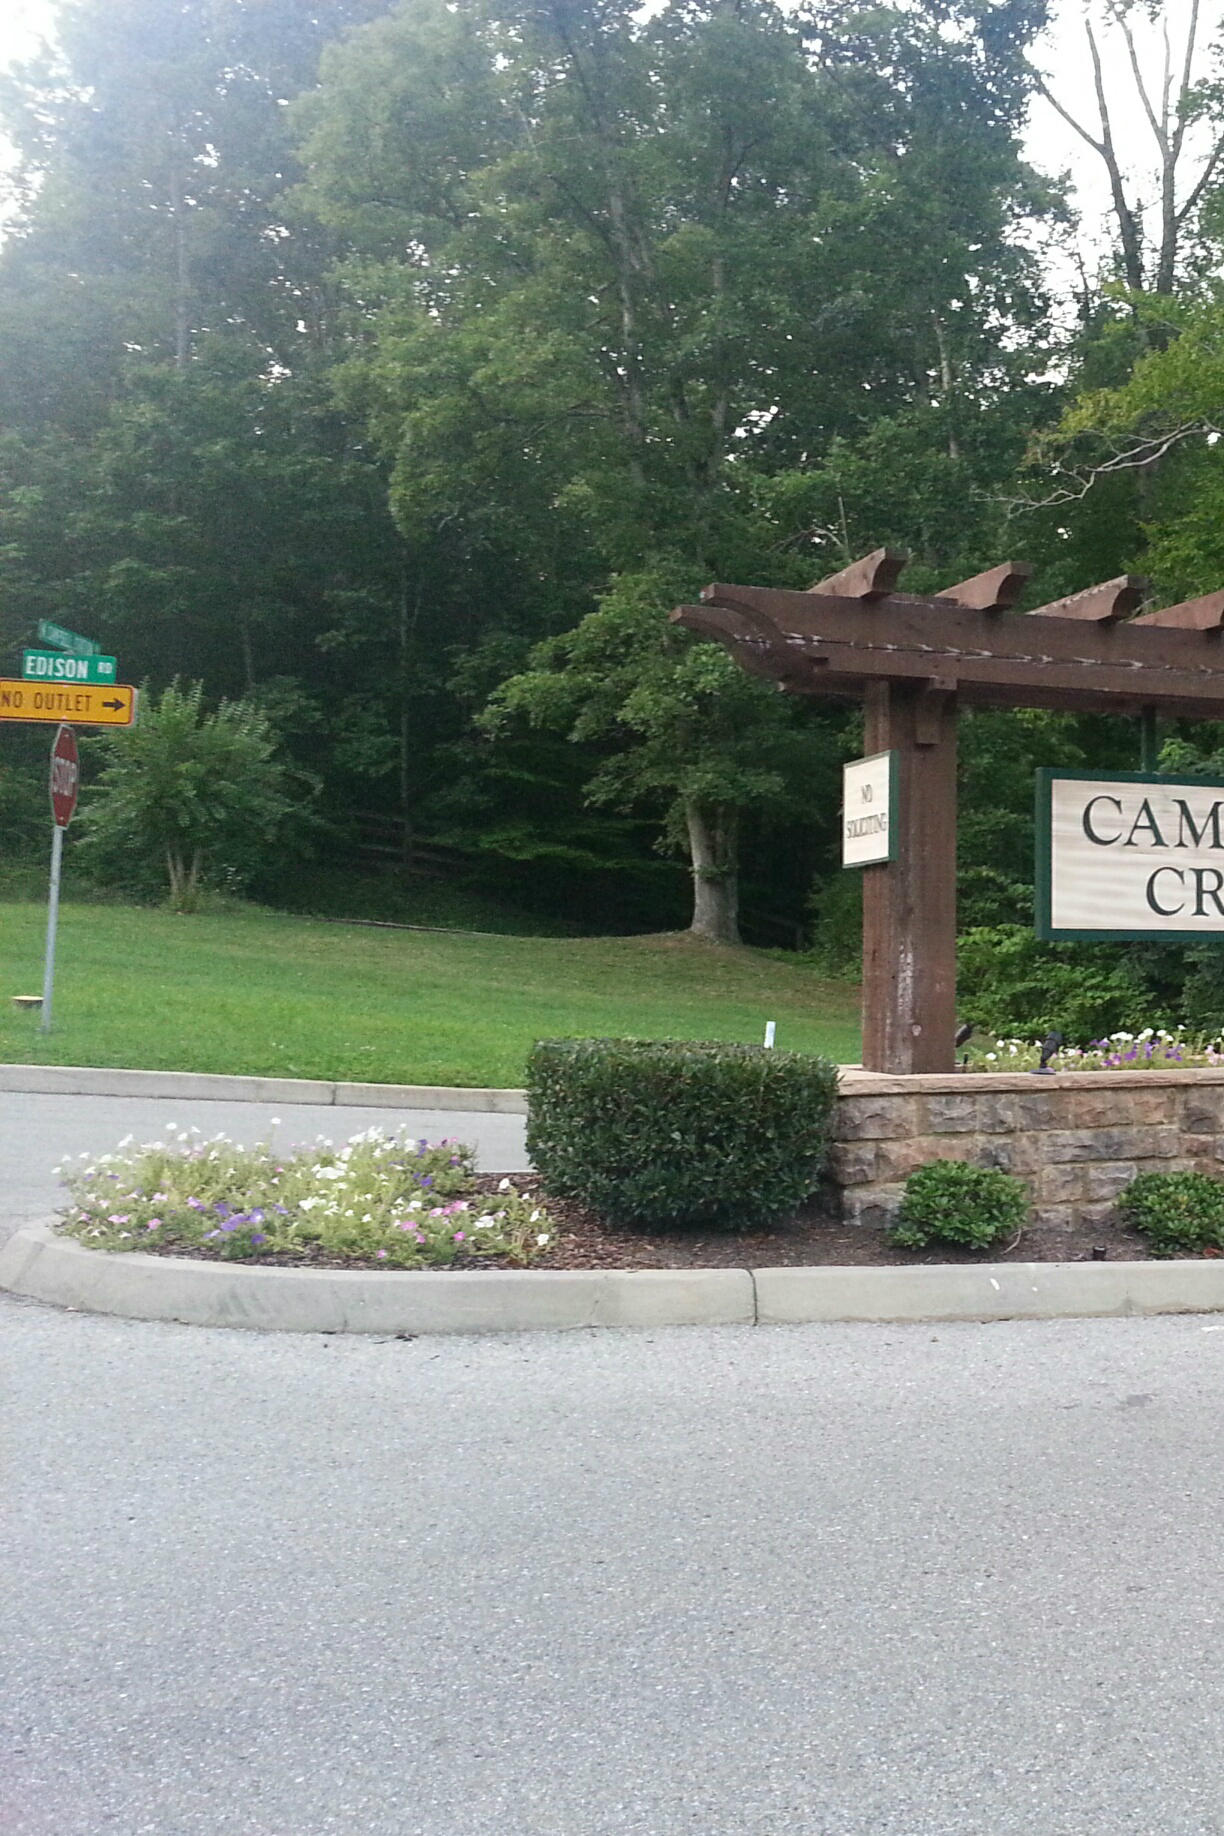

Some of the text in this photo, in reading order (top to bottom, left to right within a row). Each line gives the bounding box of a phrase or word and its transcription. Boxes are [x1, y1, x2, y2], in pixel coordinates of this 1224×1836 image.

[25, 656, 113, 679] EDISON RD
[0, 691, 92, 712] NO OUTLET
